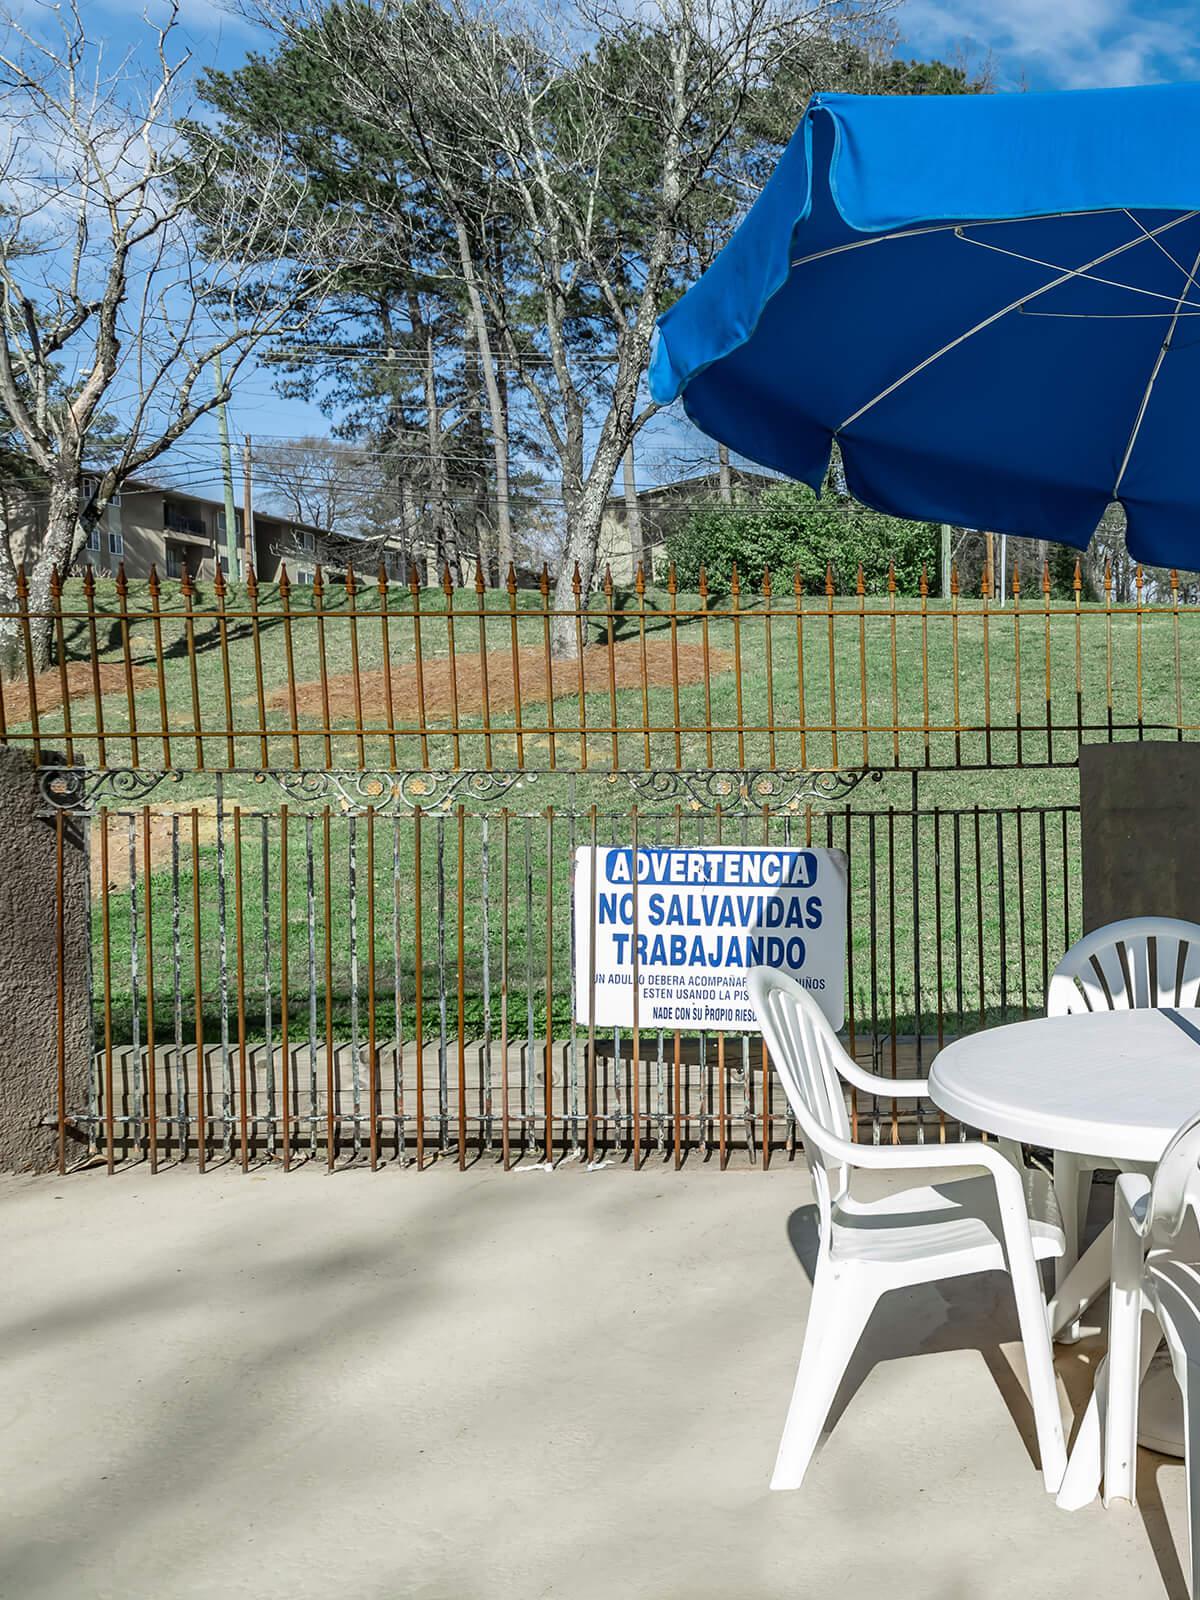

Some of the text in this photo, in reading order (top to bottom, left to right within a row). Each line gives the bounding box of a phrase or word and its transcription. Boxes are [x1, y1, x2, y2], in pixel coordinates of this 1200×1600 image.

[611, 852, 810, 884] ADVERTENCIA
[598, 893, 823, 929] NO SALVAVIDAS
[612, 933, 806, 969] TRABAJANDO
[608, 974, 645, 985] ADULO
[648, 975, 686, 986] DEBERA
[643, 988, 750, 1001] ESTEN USANDO LA PIS
[653, 1006, 758, 1022] NADE CON SU PROPIO RIES
